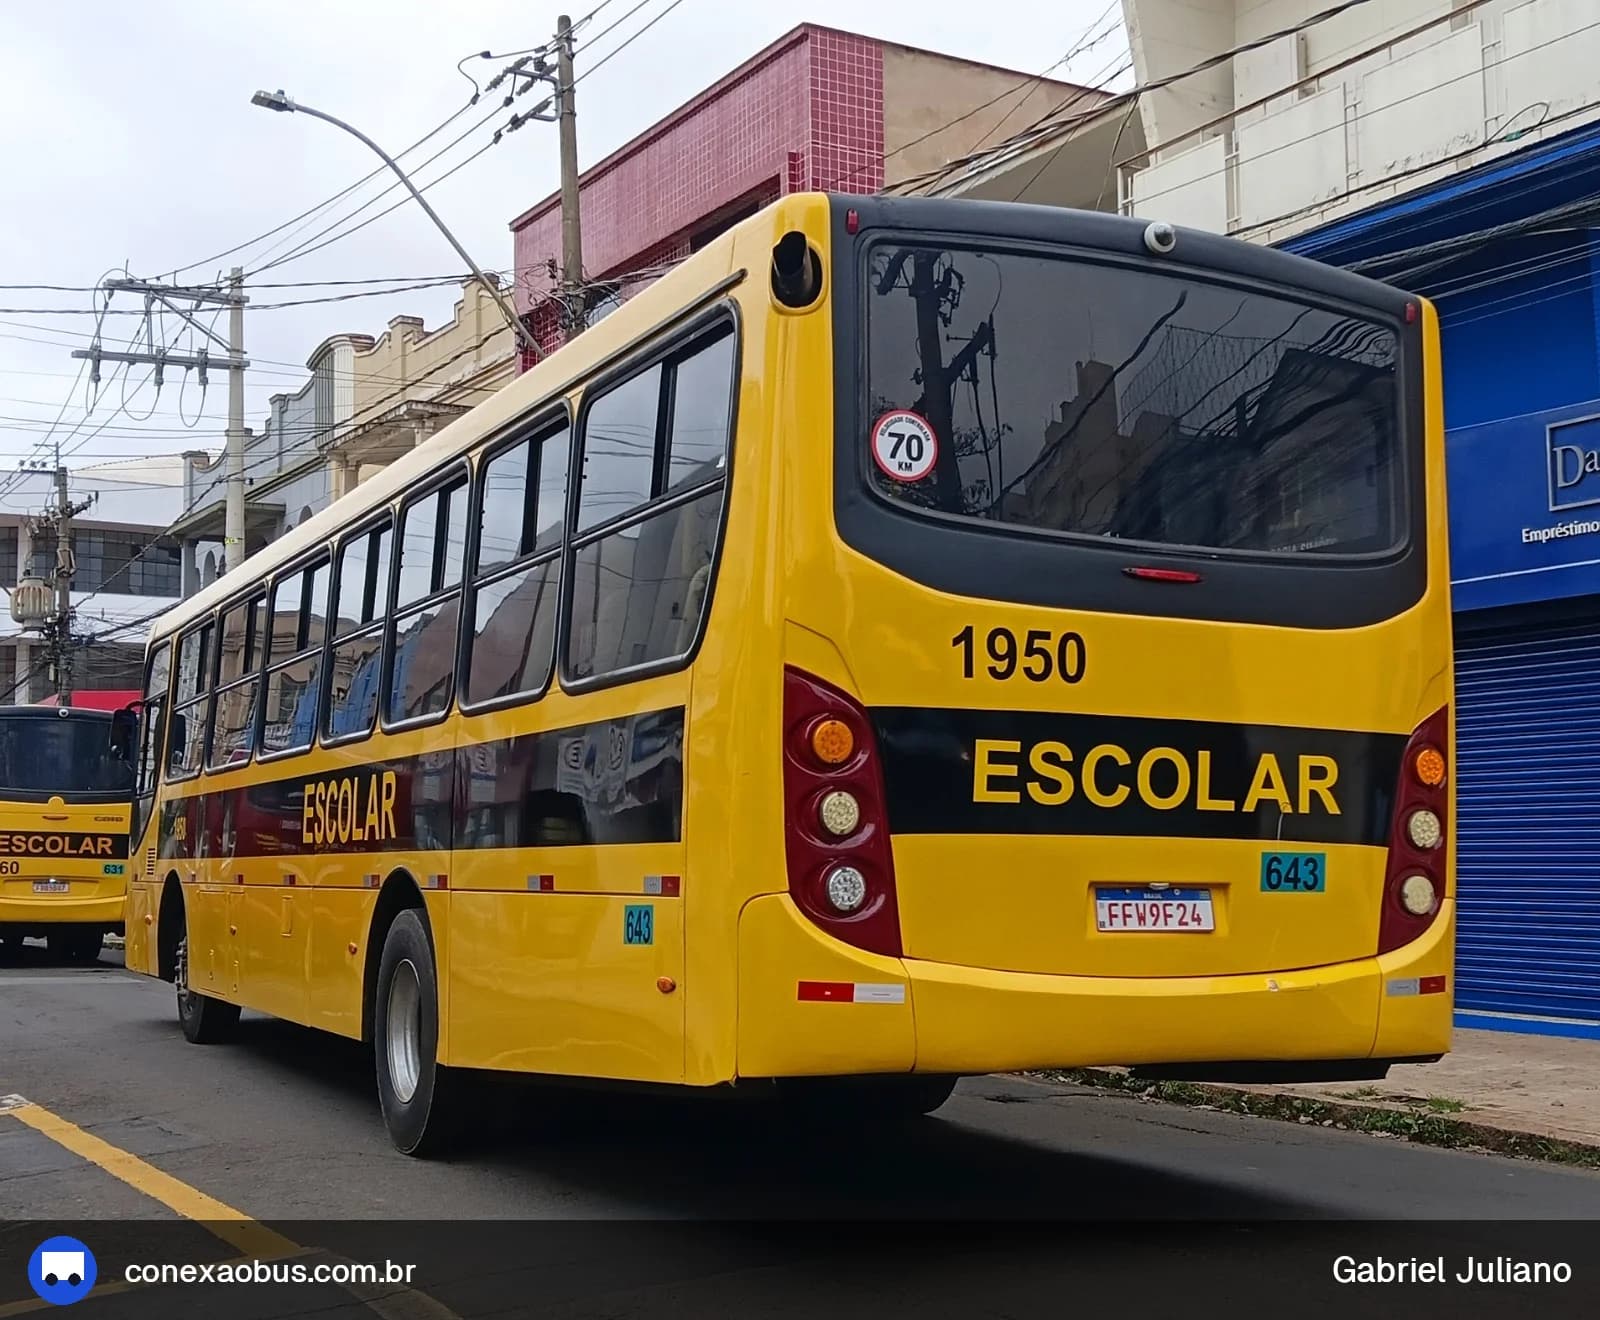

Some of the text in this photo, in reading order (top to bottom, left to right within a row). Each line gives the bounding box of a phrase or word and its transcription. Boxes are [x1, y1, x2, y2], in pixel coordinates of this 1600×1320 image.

[888, 431, 924, 462] 70
[898, 461, 913, 472] KM
[951, 625, 1087, 684] 1950
[972, 738, 1342, 815] ESCOLAR
[302, 770, 397, 845] ESCOLAR
[0, 834, 113, 855] ESCOLAR
[0, 861, 20, 875] 60
[103, 864, 123, 875] 631
[1265, 856, 1319, 891] 643
[626, 910, 651, 943] 643
[1108, 902, 1202, 927] FFW9F24
